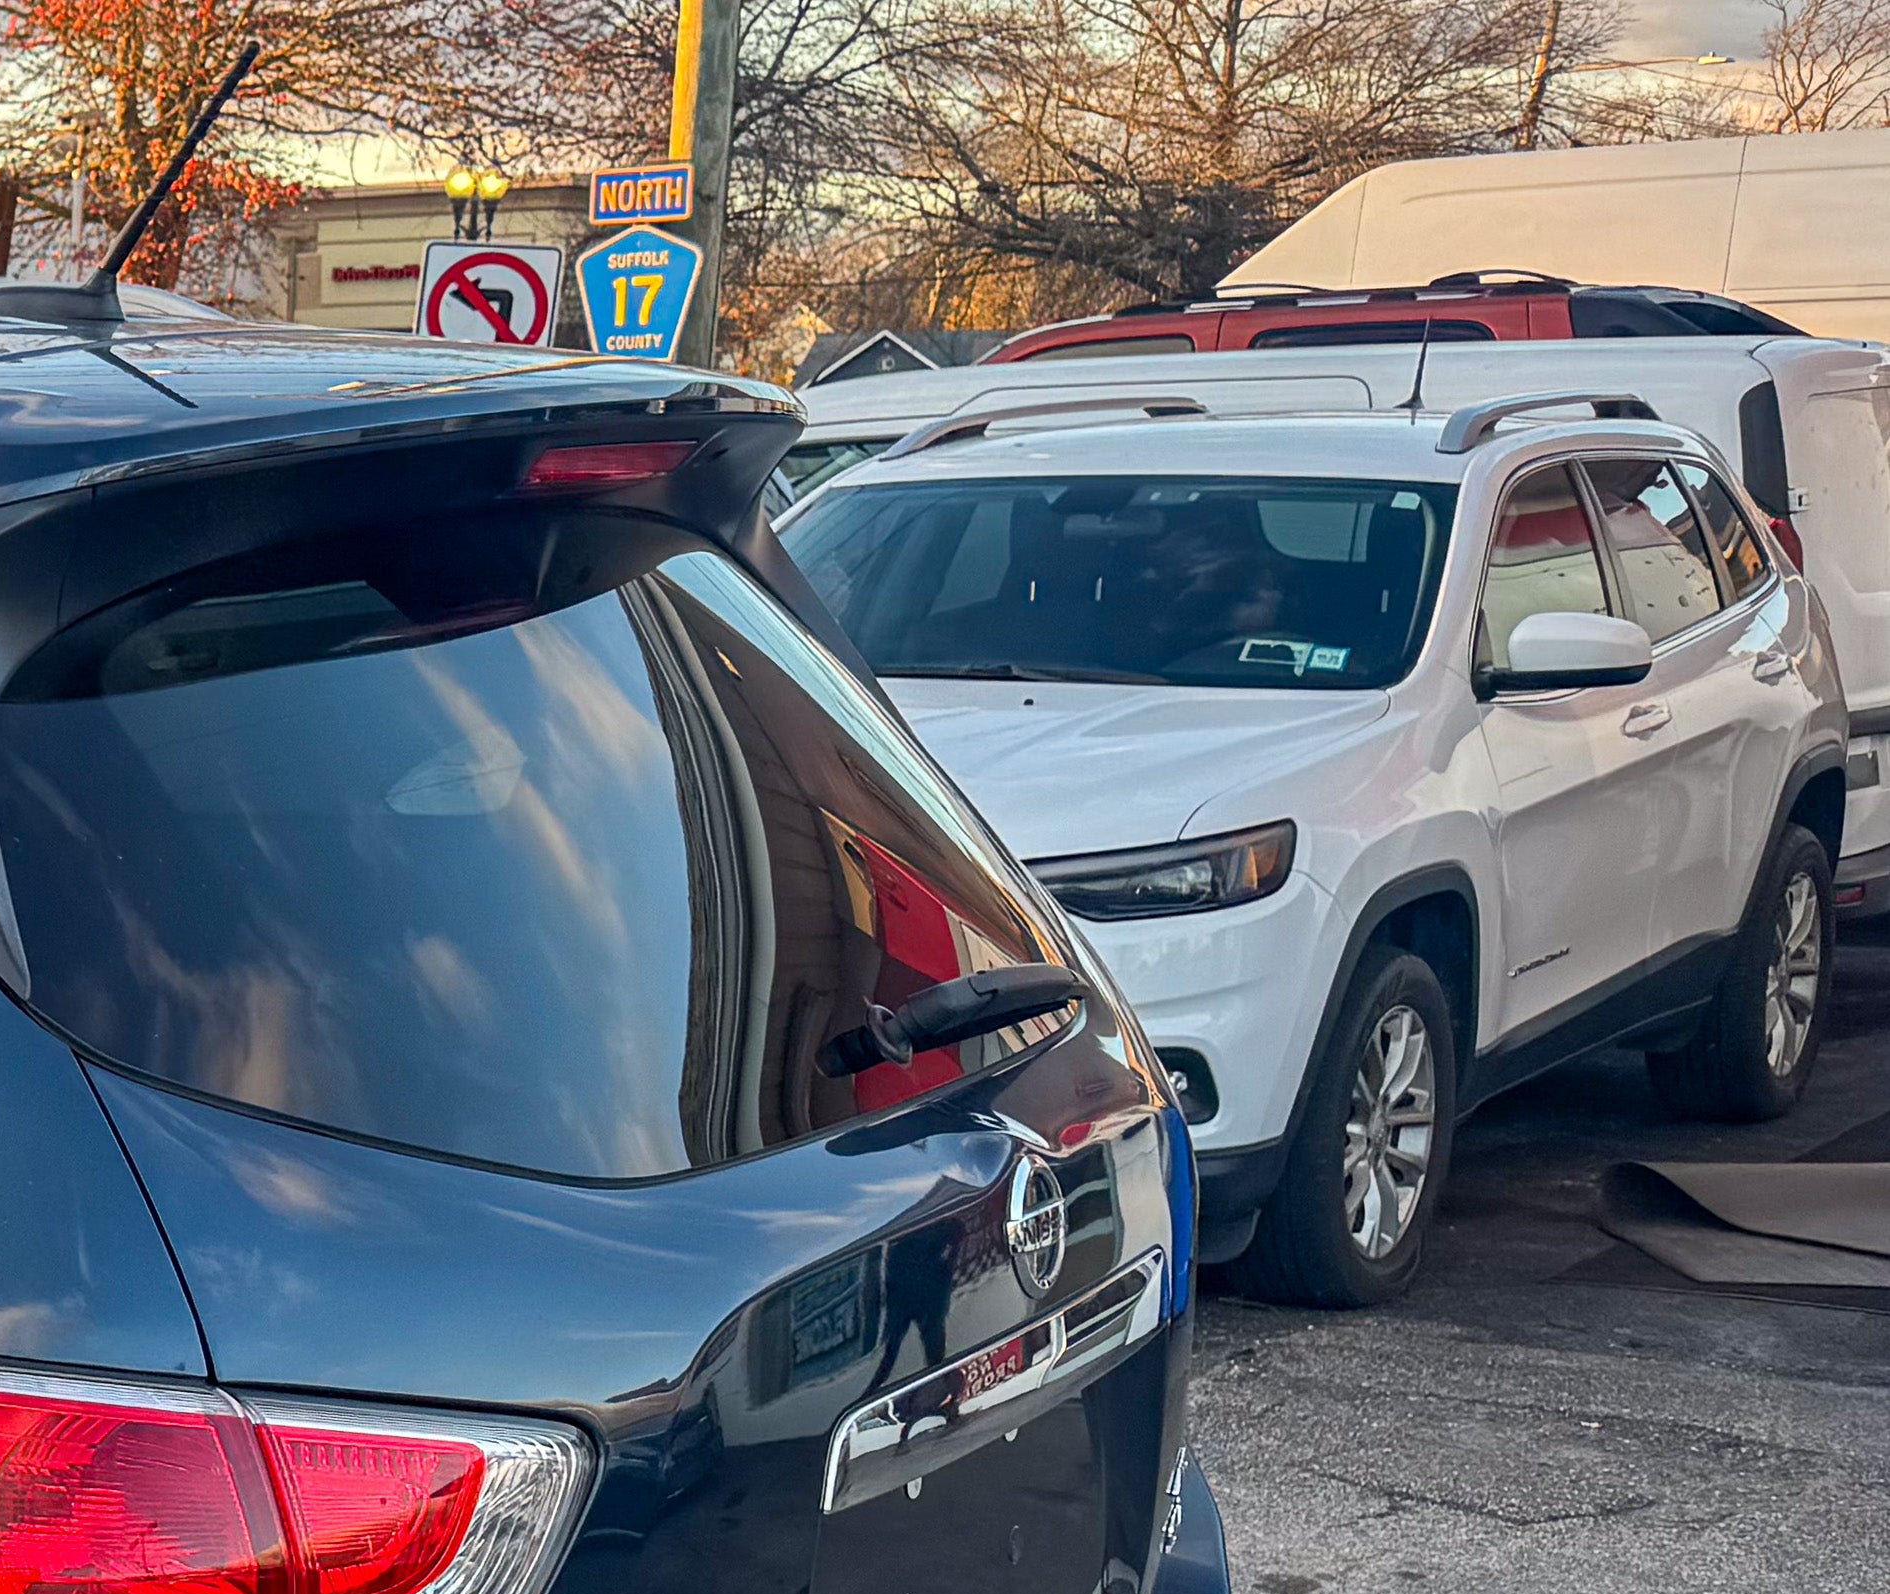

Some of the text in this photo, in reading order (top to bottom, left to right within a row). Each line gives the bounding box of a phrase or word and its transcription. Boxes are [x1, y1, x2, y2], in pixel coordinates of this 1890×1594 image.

[599, 176, 684, 212] NORTH
[608, 250, 670, 269] SUFFOLK
[613, 275, 664, 327] 17
[606, 334, 664, 351] COUNTY
